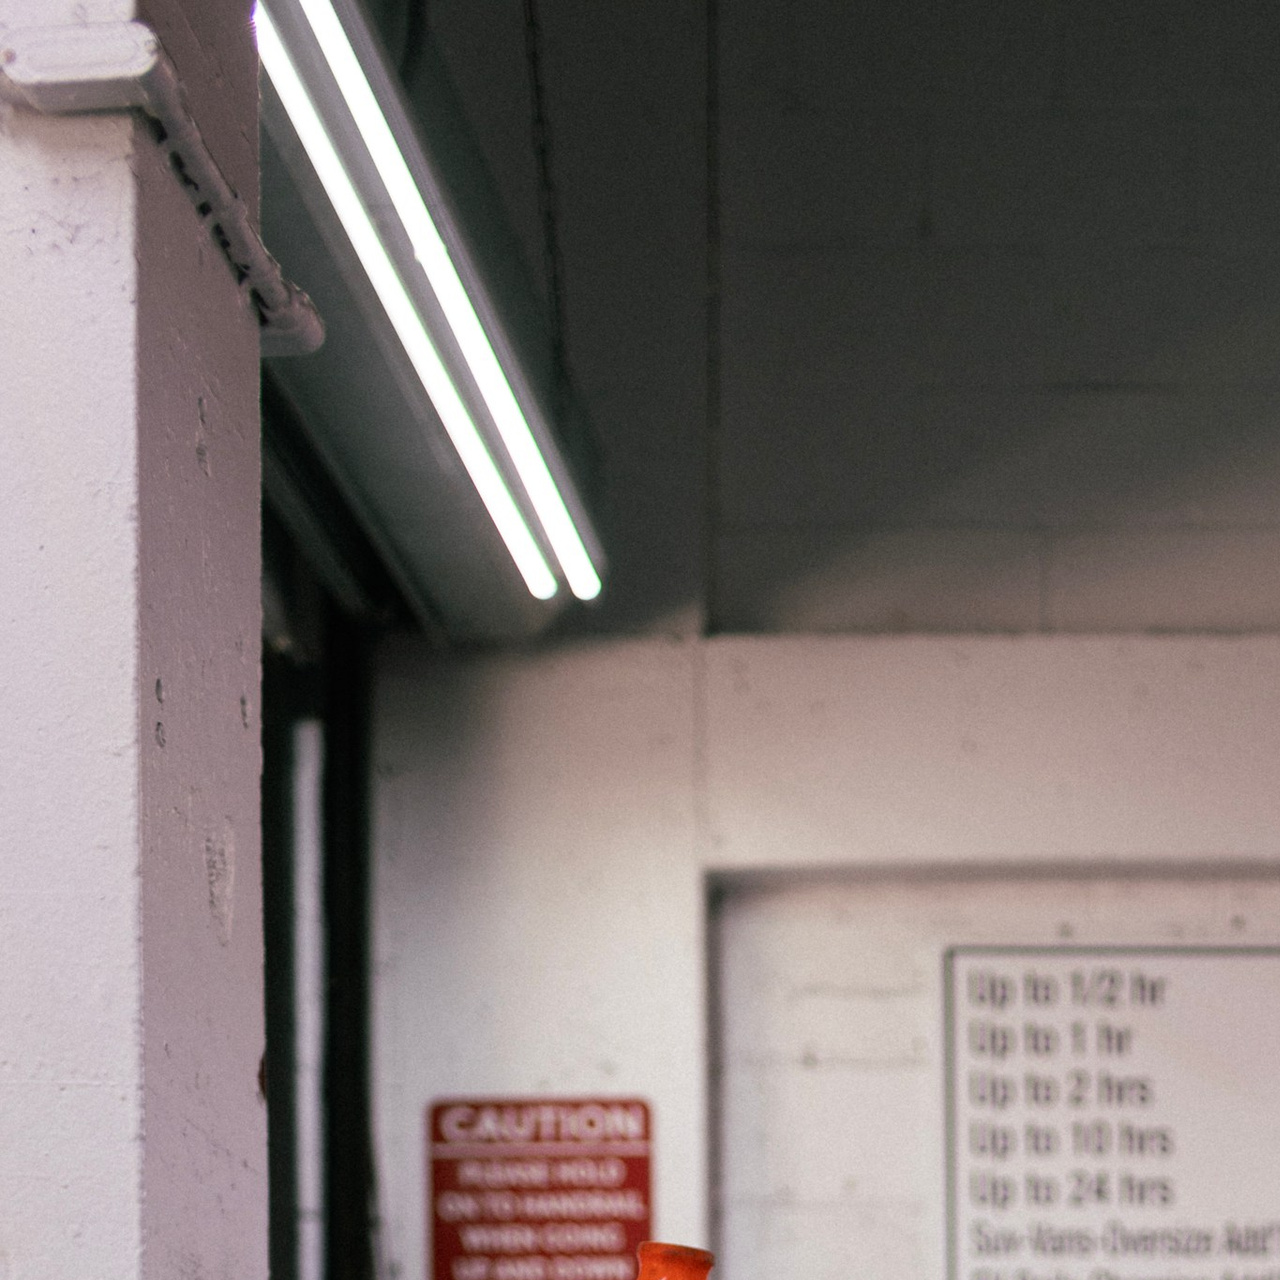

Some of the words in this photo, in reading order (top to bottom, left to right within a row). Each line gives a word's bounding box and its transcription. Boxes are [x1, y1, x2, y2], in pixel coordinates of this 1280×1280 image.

[970, 971, 1015, 1017] Up
[1025, 971, 1058, 1008] to
[1070, 971, 1123, 1008] 1/2
[1132, 971, 1169, 1008] hr
[970, 1022, 1015, 1066] Up
[1025, 1022, 1058, 1059] to
[1070, 1022, 1086, 1059] 1
[1099, 1022, 1134, 1059] hr
[970, 1073, 1016, 1115] Up
[1025, 1073, 1059, 1108] to
[1067, 1073, 1090, 1108] 2
[1099, 1073, 1155, 1108] hrs
[440, 1107, 642, 1142] CAUTION
[971, 1123, 1016, 1165] Up
[1026, 1123, 1059, 1159] to
[1069, 1123, 1111, 1159] 10
[1120, 1123, 1176, 1159] hrs
[460, 1162, 551, 1185] PLEASE
[555, 1162, 625, 1185] HOLD
[971, 1173, 1016, 1215] Up
[1026, 1173, 1059, 1209] to
[1067, 1173, 1110, 1209] 24
[1120, 1173, 1176, 1209] hrs
[462, 1227, 539, 1251] WHEN
